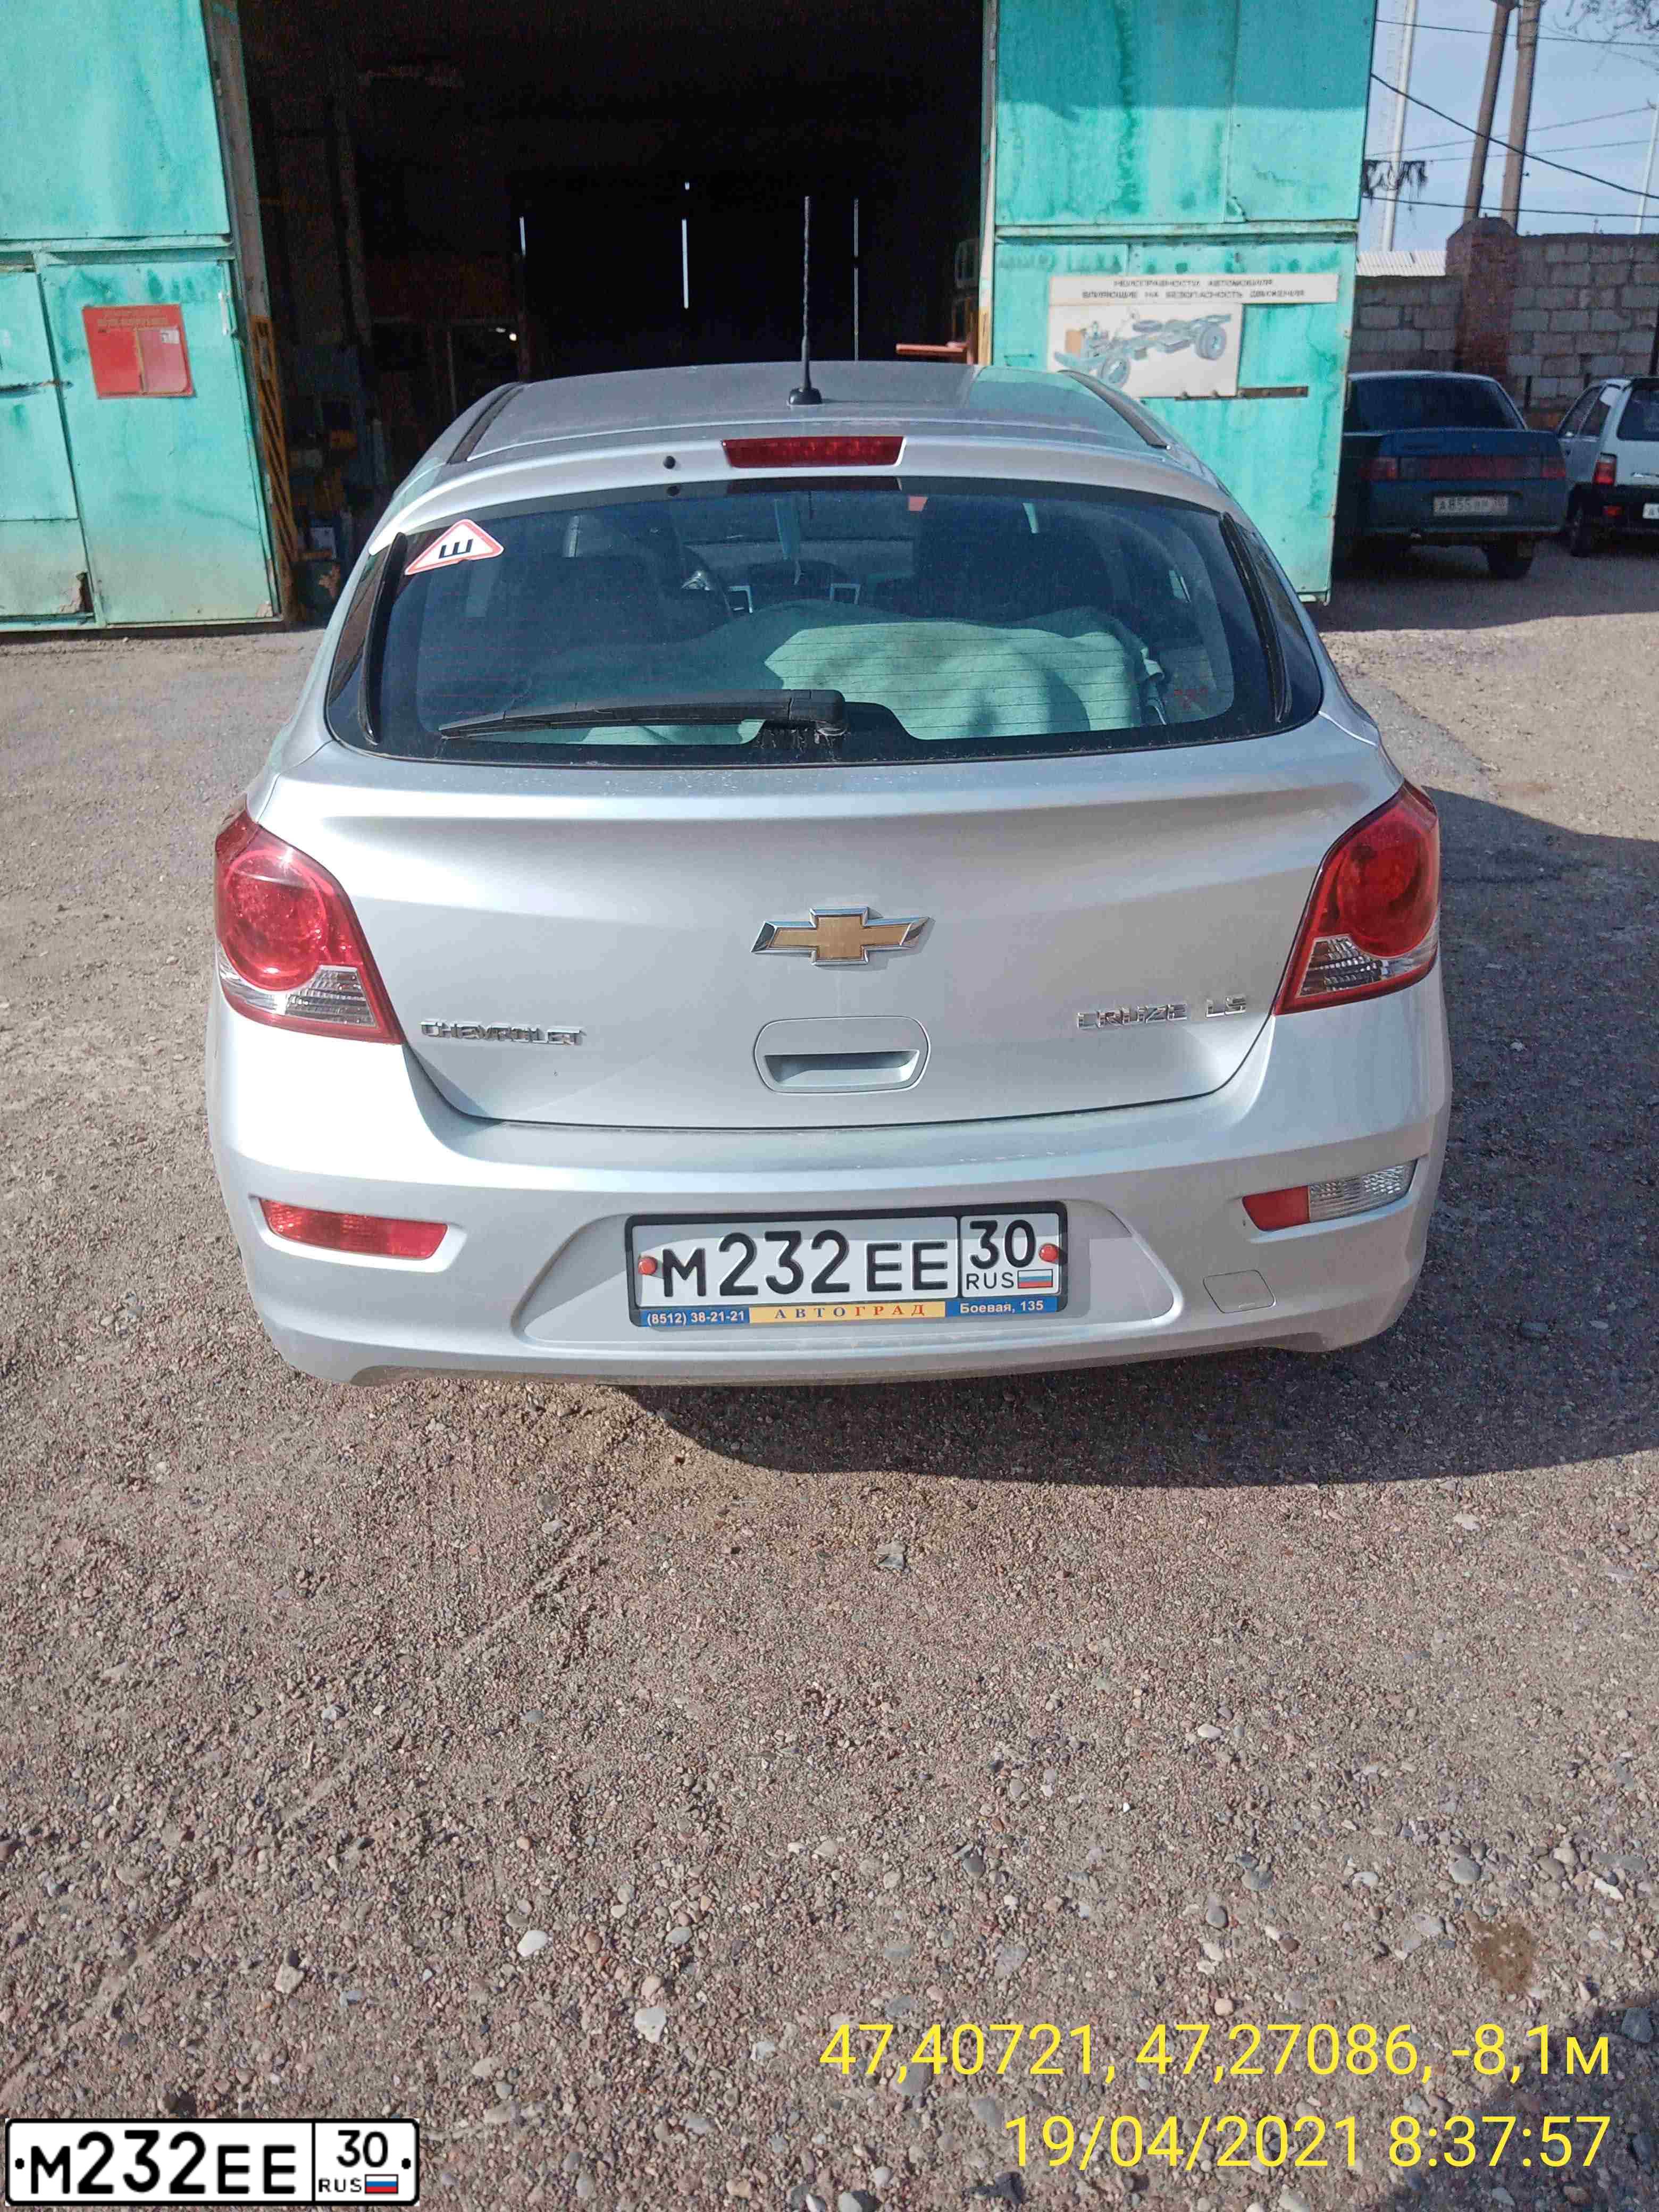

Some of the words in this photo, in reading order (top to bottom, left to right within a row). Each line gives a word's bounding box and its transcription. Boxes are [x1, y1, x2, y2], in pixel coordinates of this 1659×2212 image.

[438, 539, 473, 559] Ш
[420, 1018, 584, 1045] CHEVROLET
[969, 1219, 1036, 1270] 30
[661, 1228, 948, 1297] М232ЕЕ
[966, 1271, 1015, 1291] RUS
[774, 1304, 925, 1319] АВТОГРАД
[960, 1302, 1015, 1314] Боевая,
[1020, 1301, 1044, 1311] 135
[647, 1312, 687, 1326] (8512)
[691, 1310, 744, 1323] 38-21-21
